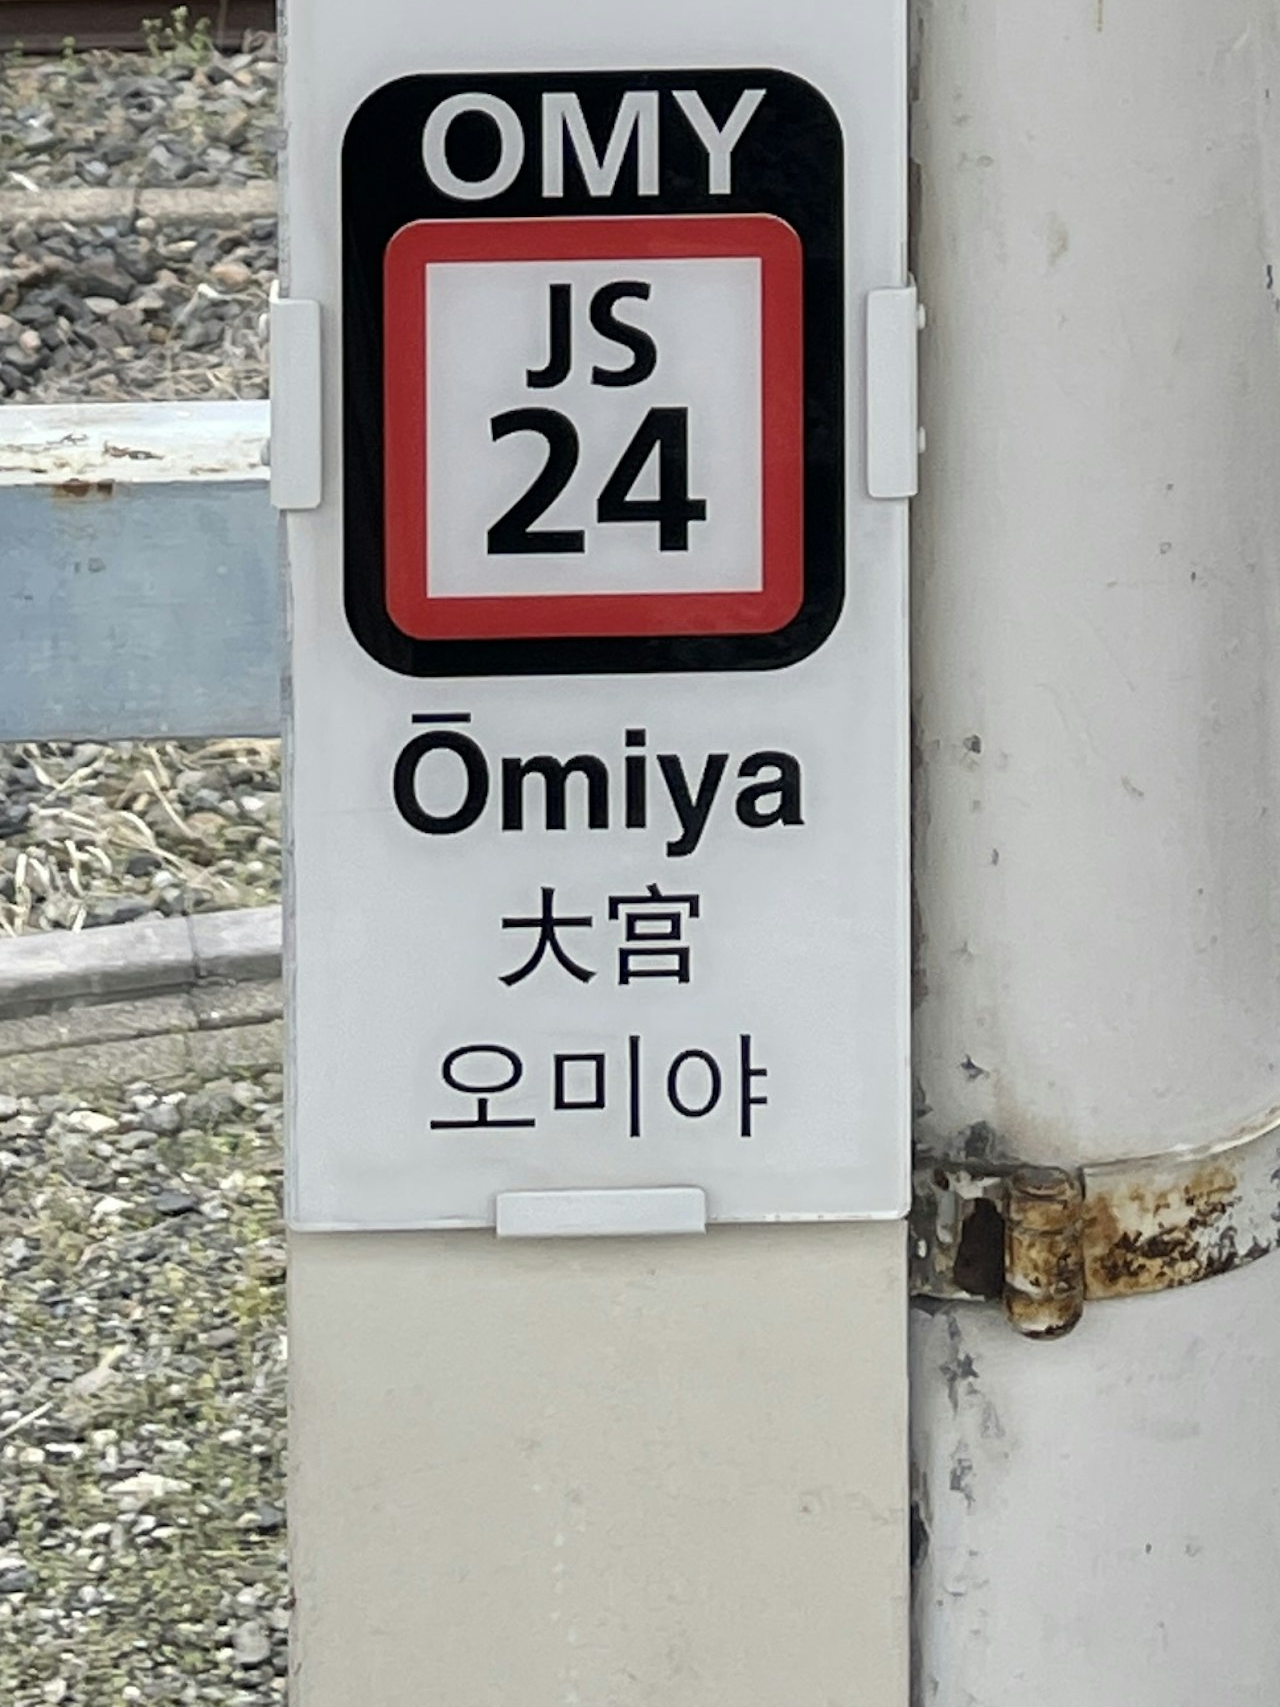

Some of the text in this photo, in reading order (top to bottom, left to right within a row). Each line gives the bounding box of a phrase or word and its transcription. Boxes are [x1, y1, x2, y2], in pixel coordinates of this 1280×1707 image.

[422, 89, 767, 200] OMY
[525, 280, 658, 390] JS
[486, 405, 708, 556] 24
[393, 712, 805, 858] Ōmiya
[430, 1034, 768, 1138] 오미야
